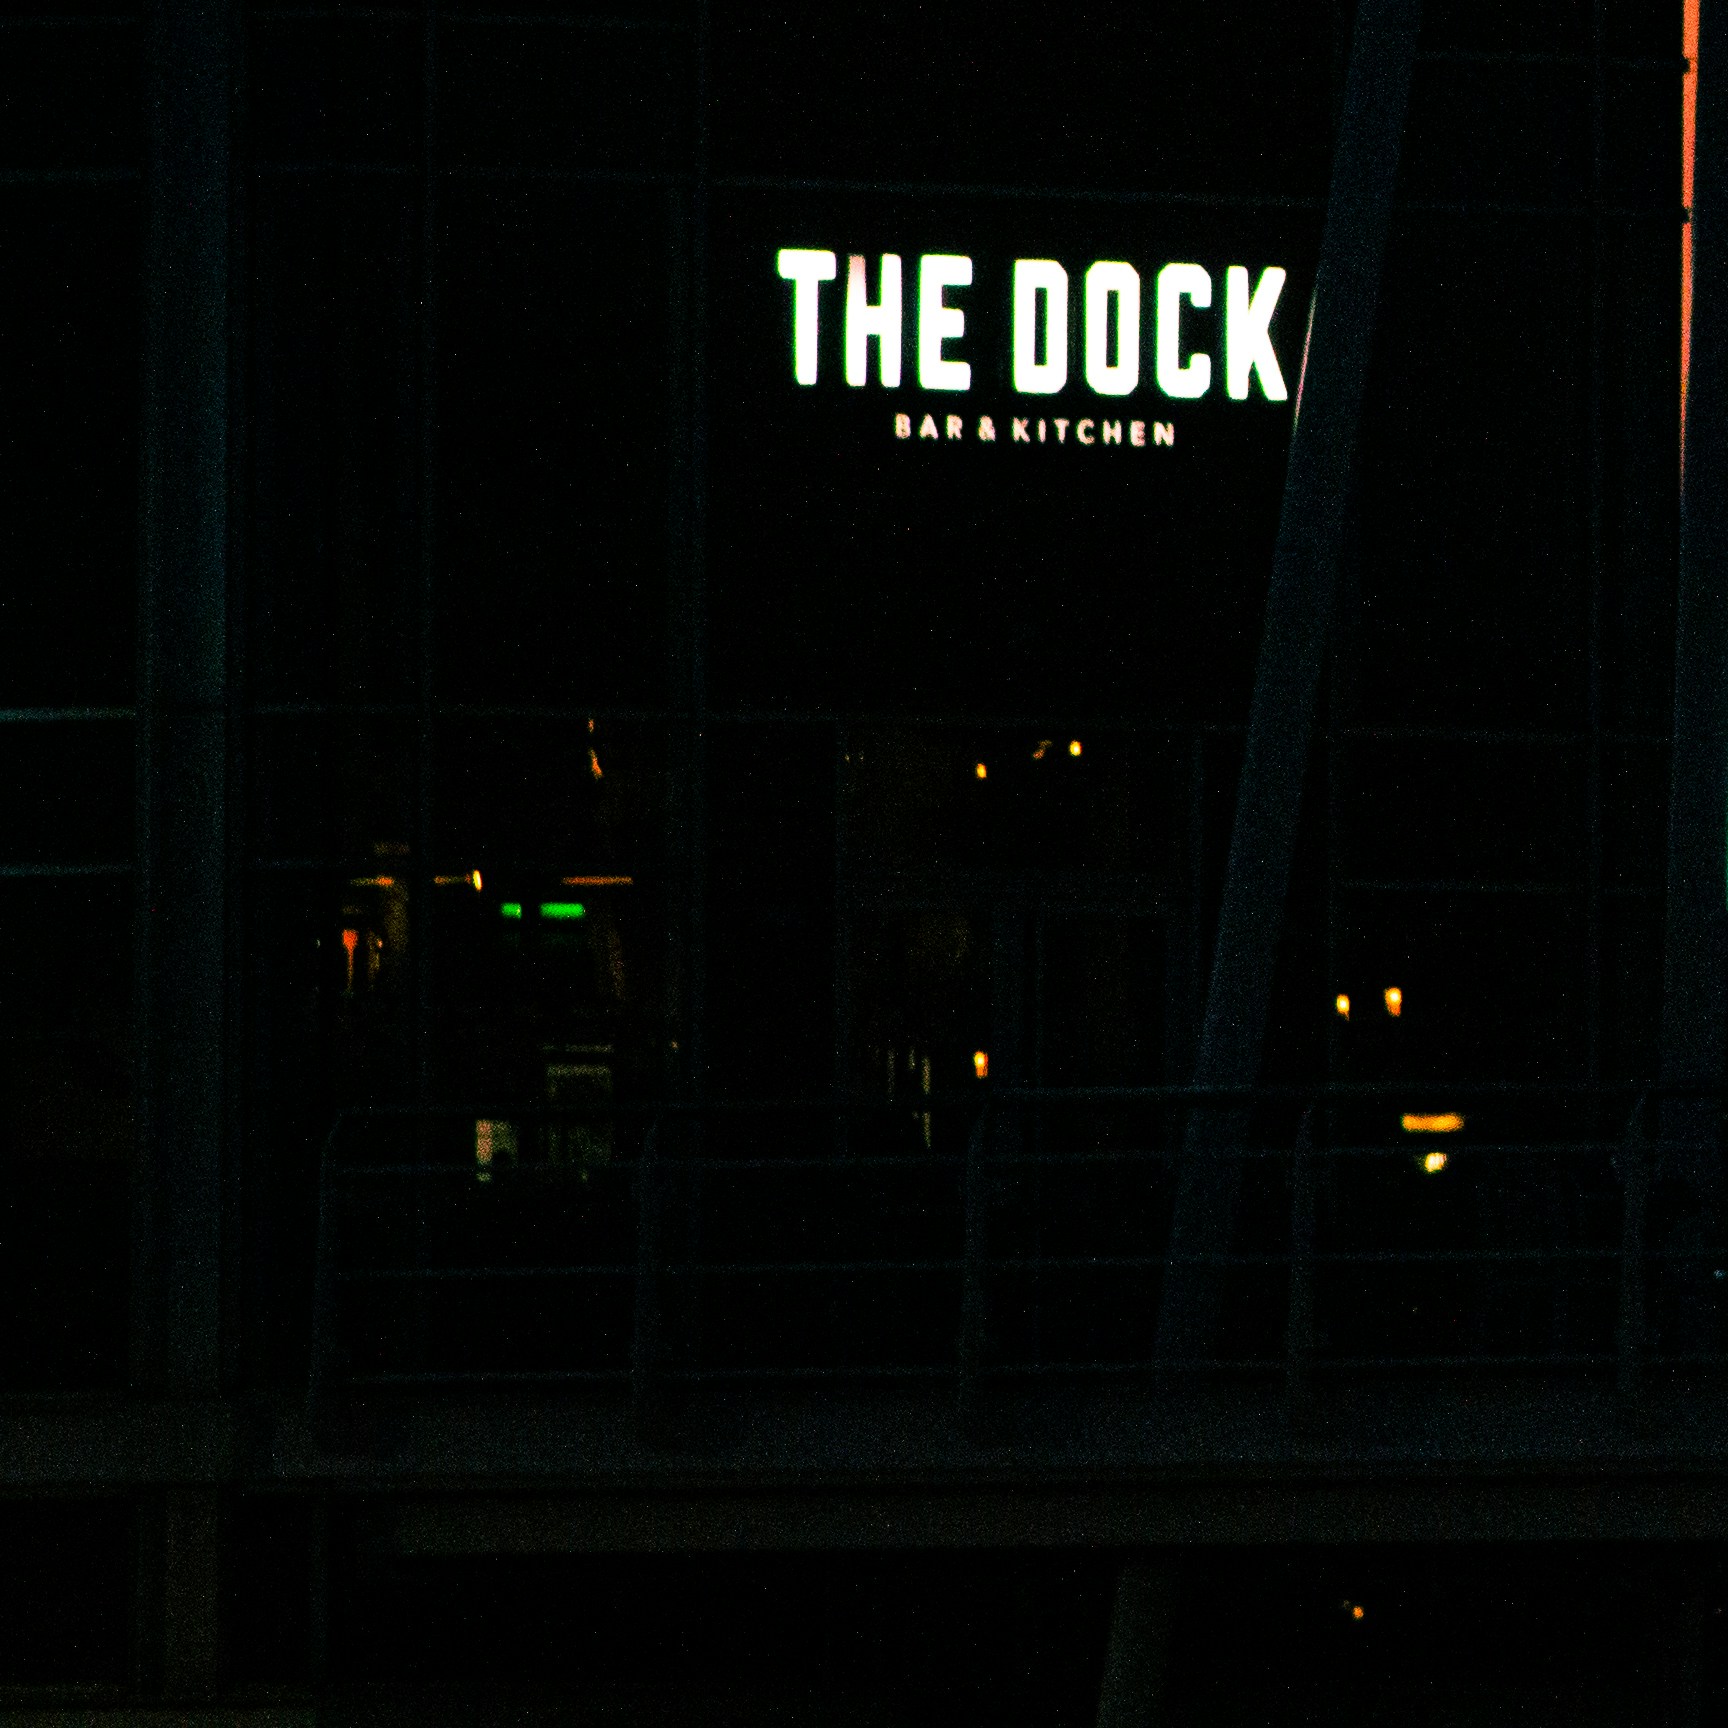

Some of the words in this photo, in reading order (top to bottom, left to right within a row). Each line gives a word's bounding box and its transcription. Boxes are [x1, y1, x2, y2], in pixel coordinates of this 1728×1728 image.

[776, 248, 974, 391] THE
[1012, 258, 1289, 402] DOCK
[894, 413, 963, 440] BAR
[978, 415, 996, 442] &
[1012, 417, 1175, 447] KITCHEN
